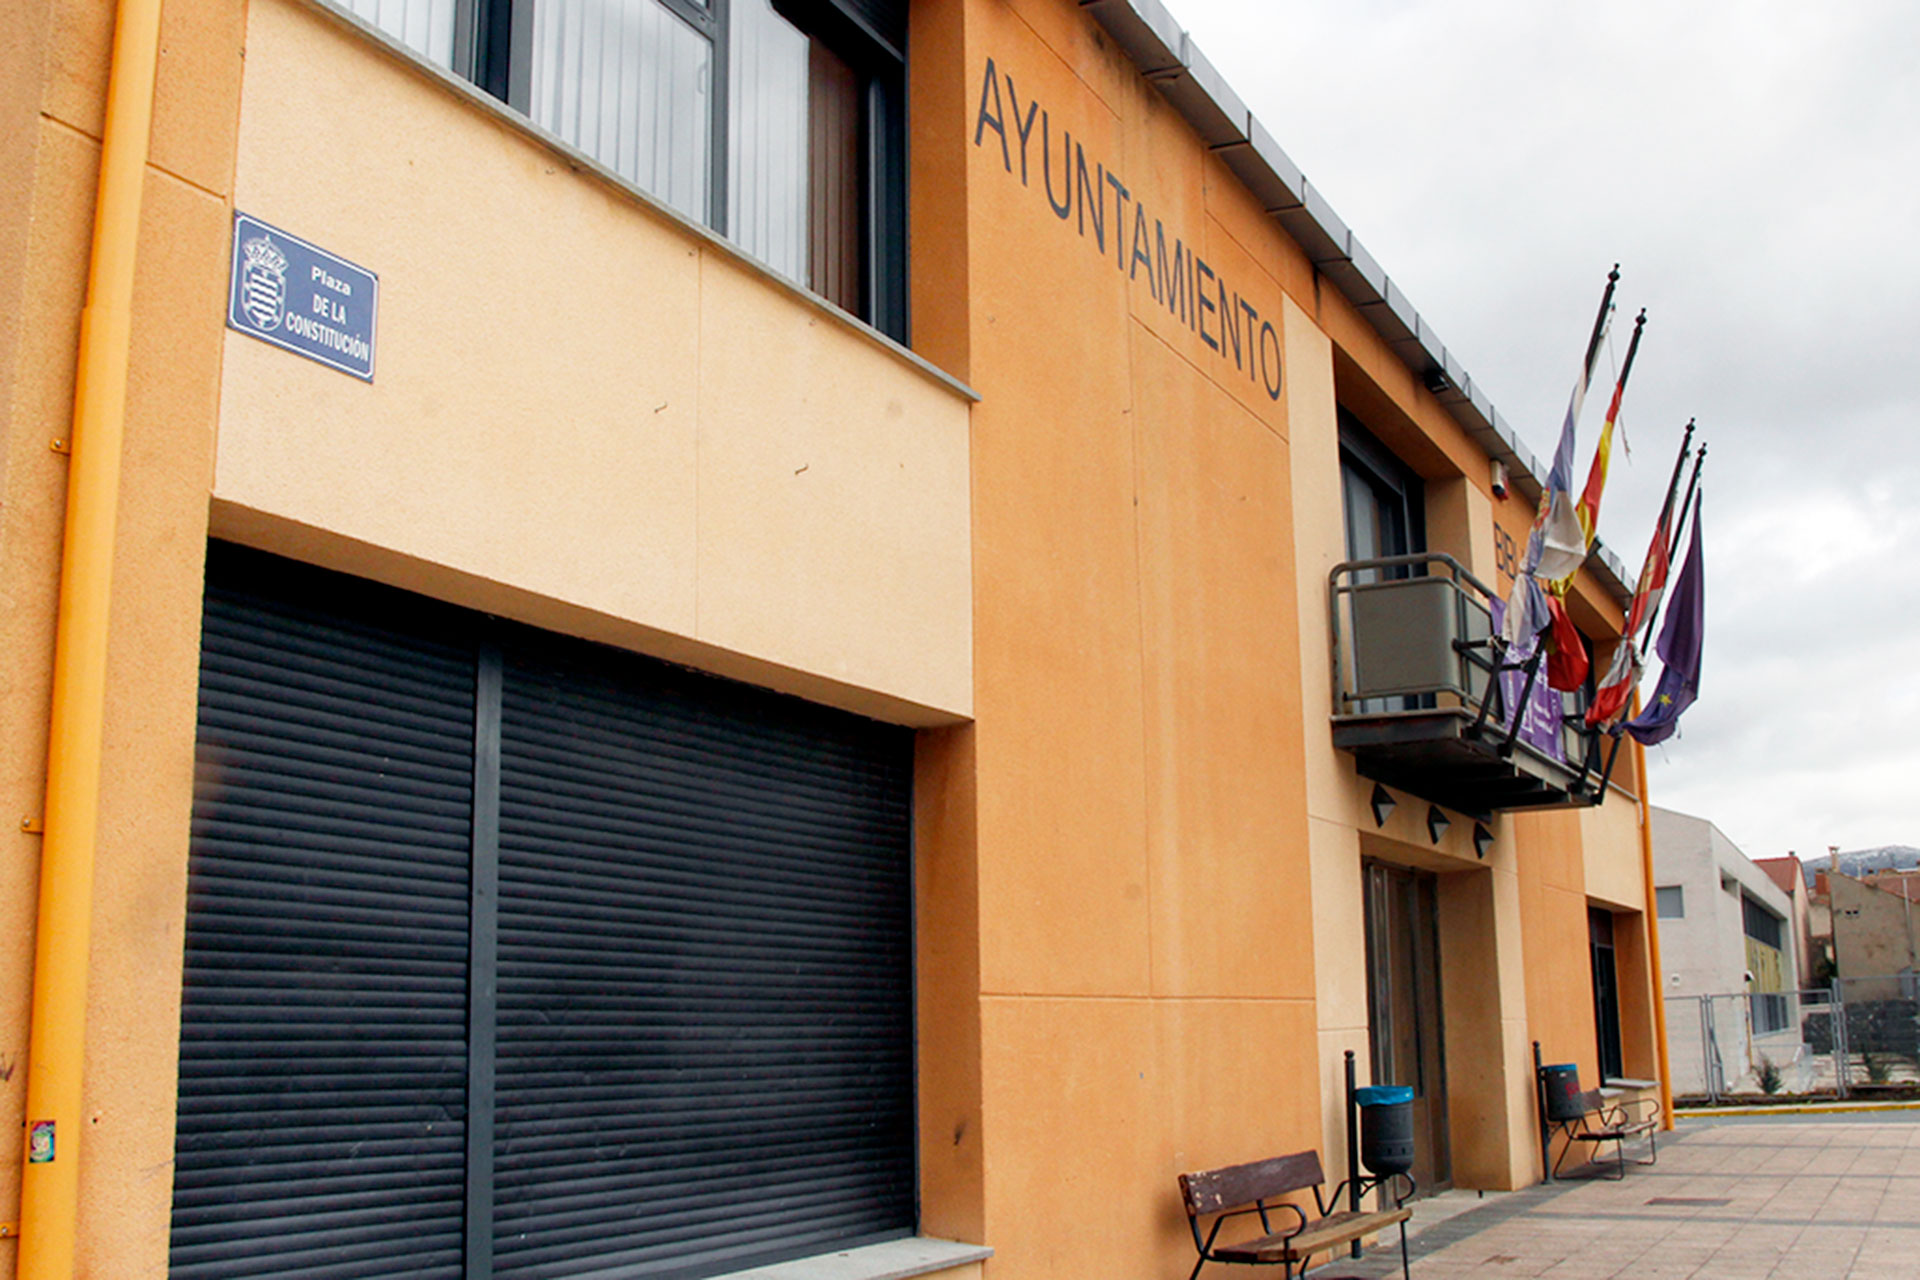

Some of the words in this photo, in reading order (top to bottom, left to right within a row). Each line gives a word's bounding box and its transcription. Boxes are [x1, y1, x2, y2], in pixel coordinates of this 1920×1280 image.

[975, 56, 1282, 401] AYUNTAMIENTO
[311, 265, 351, 296] Plaza
[312, 293, 330, 318] DE
[331, 301, 346, 325] LA
[285, 311, 369, 362] CONSTITUCIÓN
